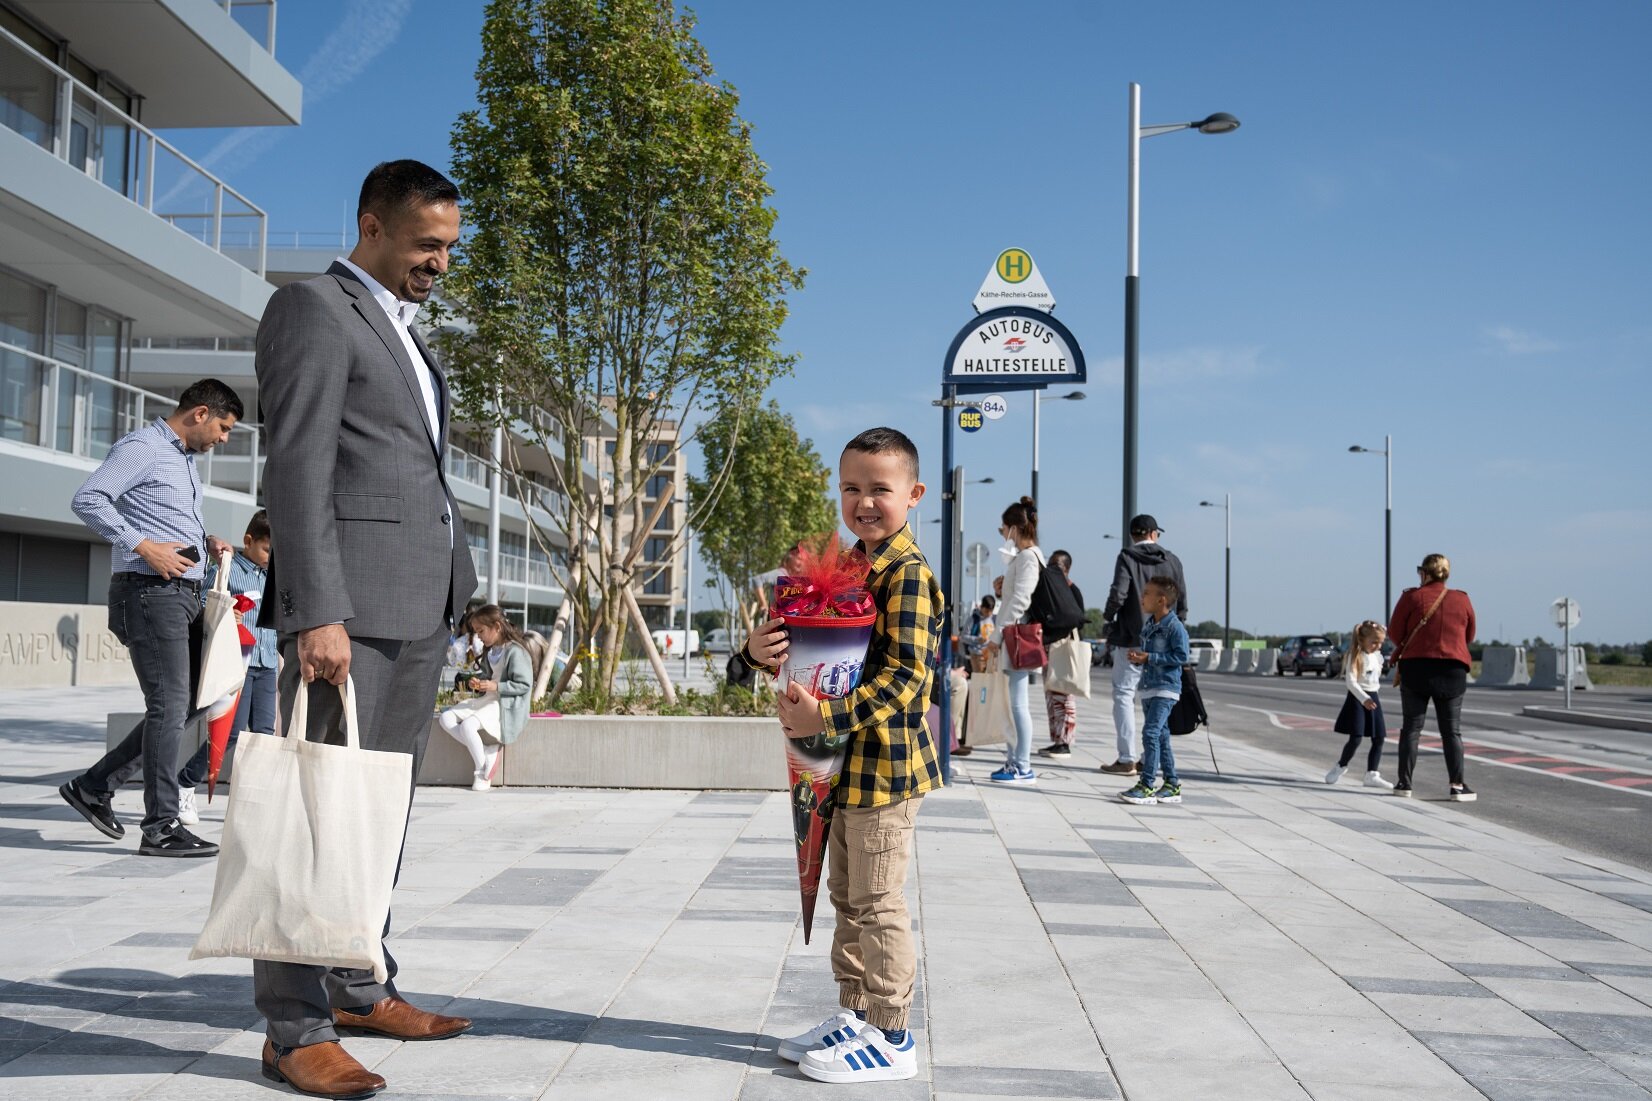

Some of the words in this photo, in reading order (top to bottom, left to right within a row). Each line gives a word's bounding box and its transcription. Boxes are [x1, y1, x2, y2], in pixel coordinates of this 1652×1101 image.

[1005, 255, 1023, 277] H
[979, 319, 1054, 344] AUTOBUS
[964, 358, 1066, 372] HALTESTELLE
[983, 402, 1005, 413] 84A
[960, 420, 981, 428] BUS
[85, 633, 131, 662] LISE
